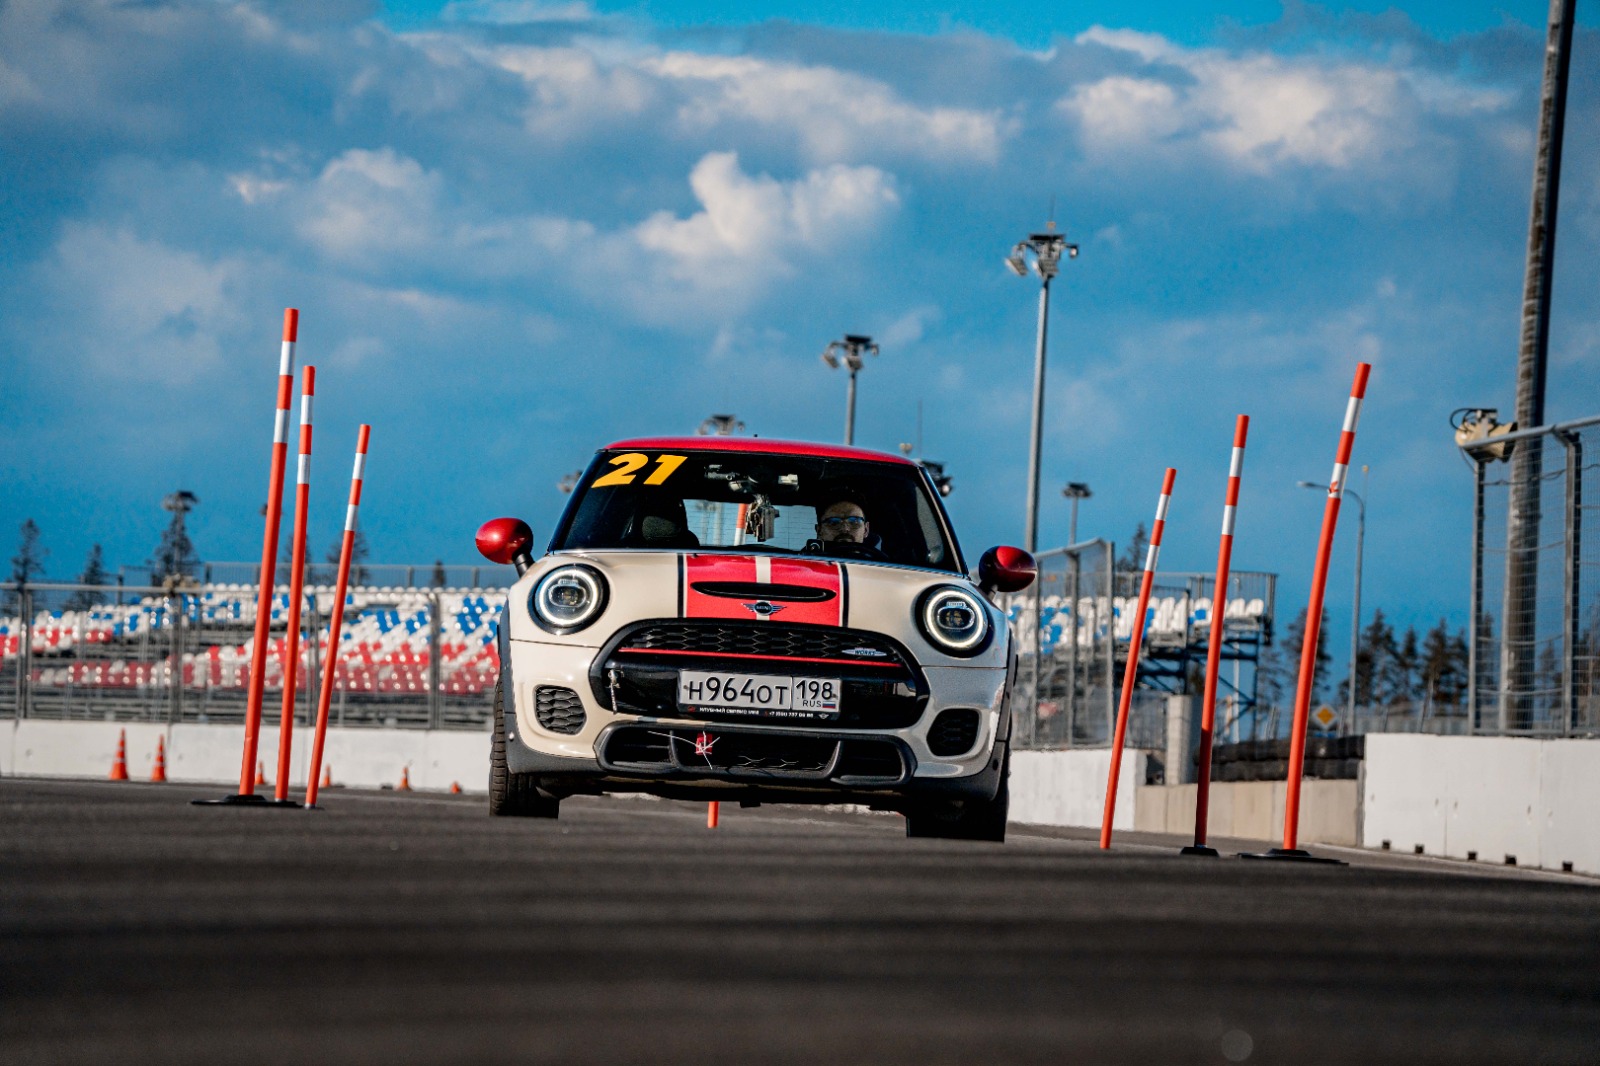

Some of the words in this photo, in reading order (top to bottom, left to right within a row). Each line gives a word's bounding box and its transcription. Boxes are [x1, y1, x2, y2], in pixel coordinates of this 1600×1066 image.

[591, 453, 688, 488] 21
[795, 680, 833, 700] 198
[803, 700, 822, 708] RUS
